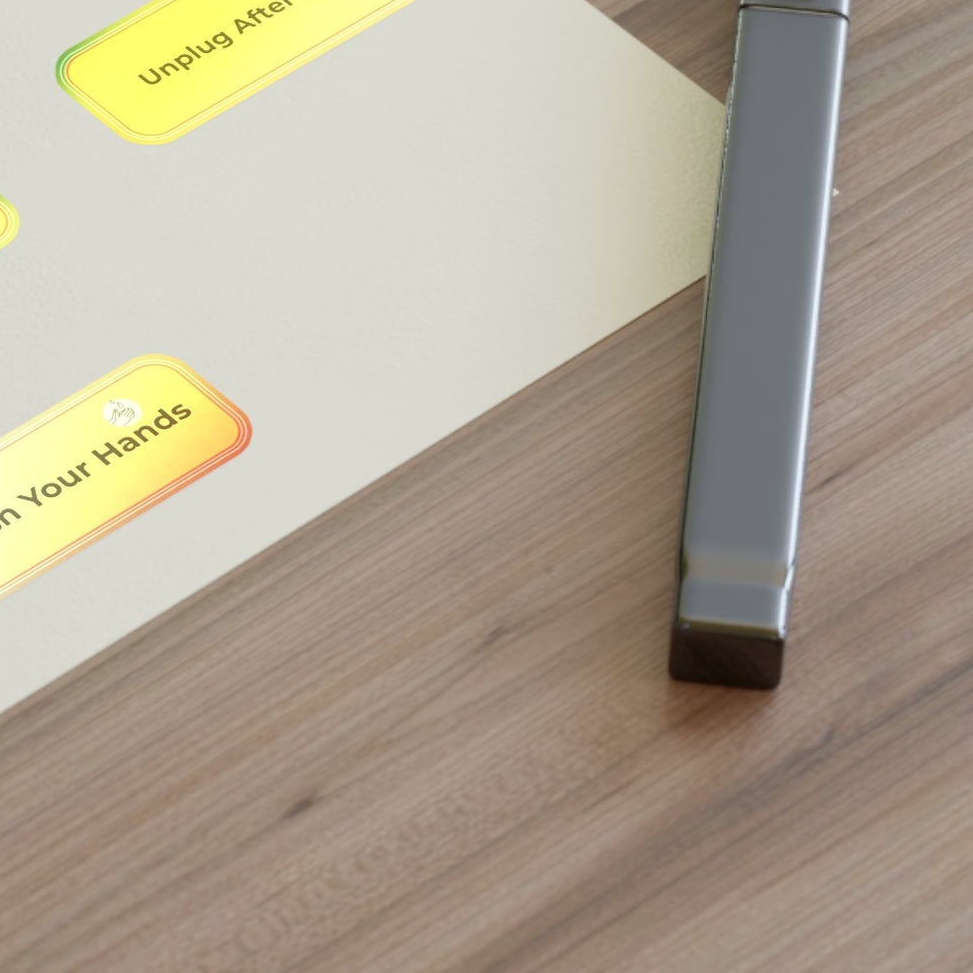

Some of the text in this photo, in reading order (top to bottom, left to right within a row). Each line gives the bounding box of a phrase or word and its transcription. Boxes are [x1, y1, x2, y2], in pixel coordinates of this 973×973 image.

[138, 31, 234, 86] Unplug
[16, 460, 92, 507] Your
[91, 401, 193, 466] Hands
